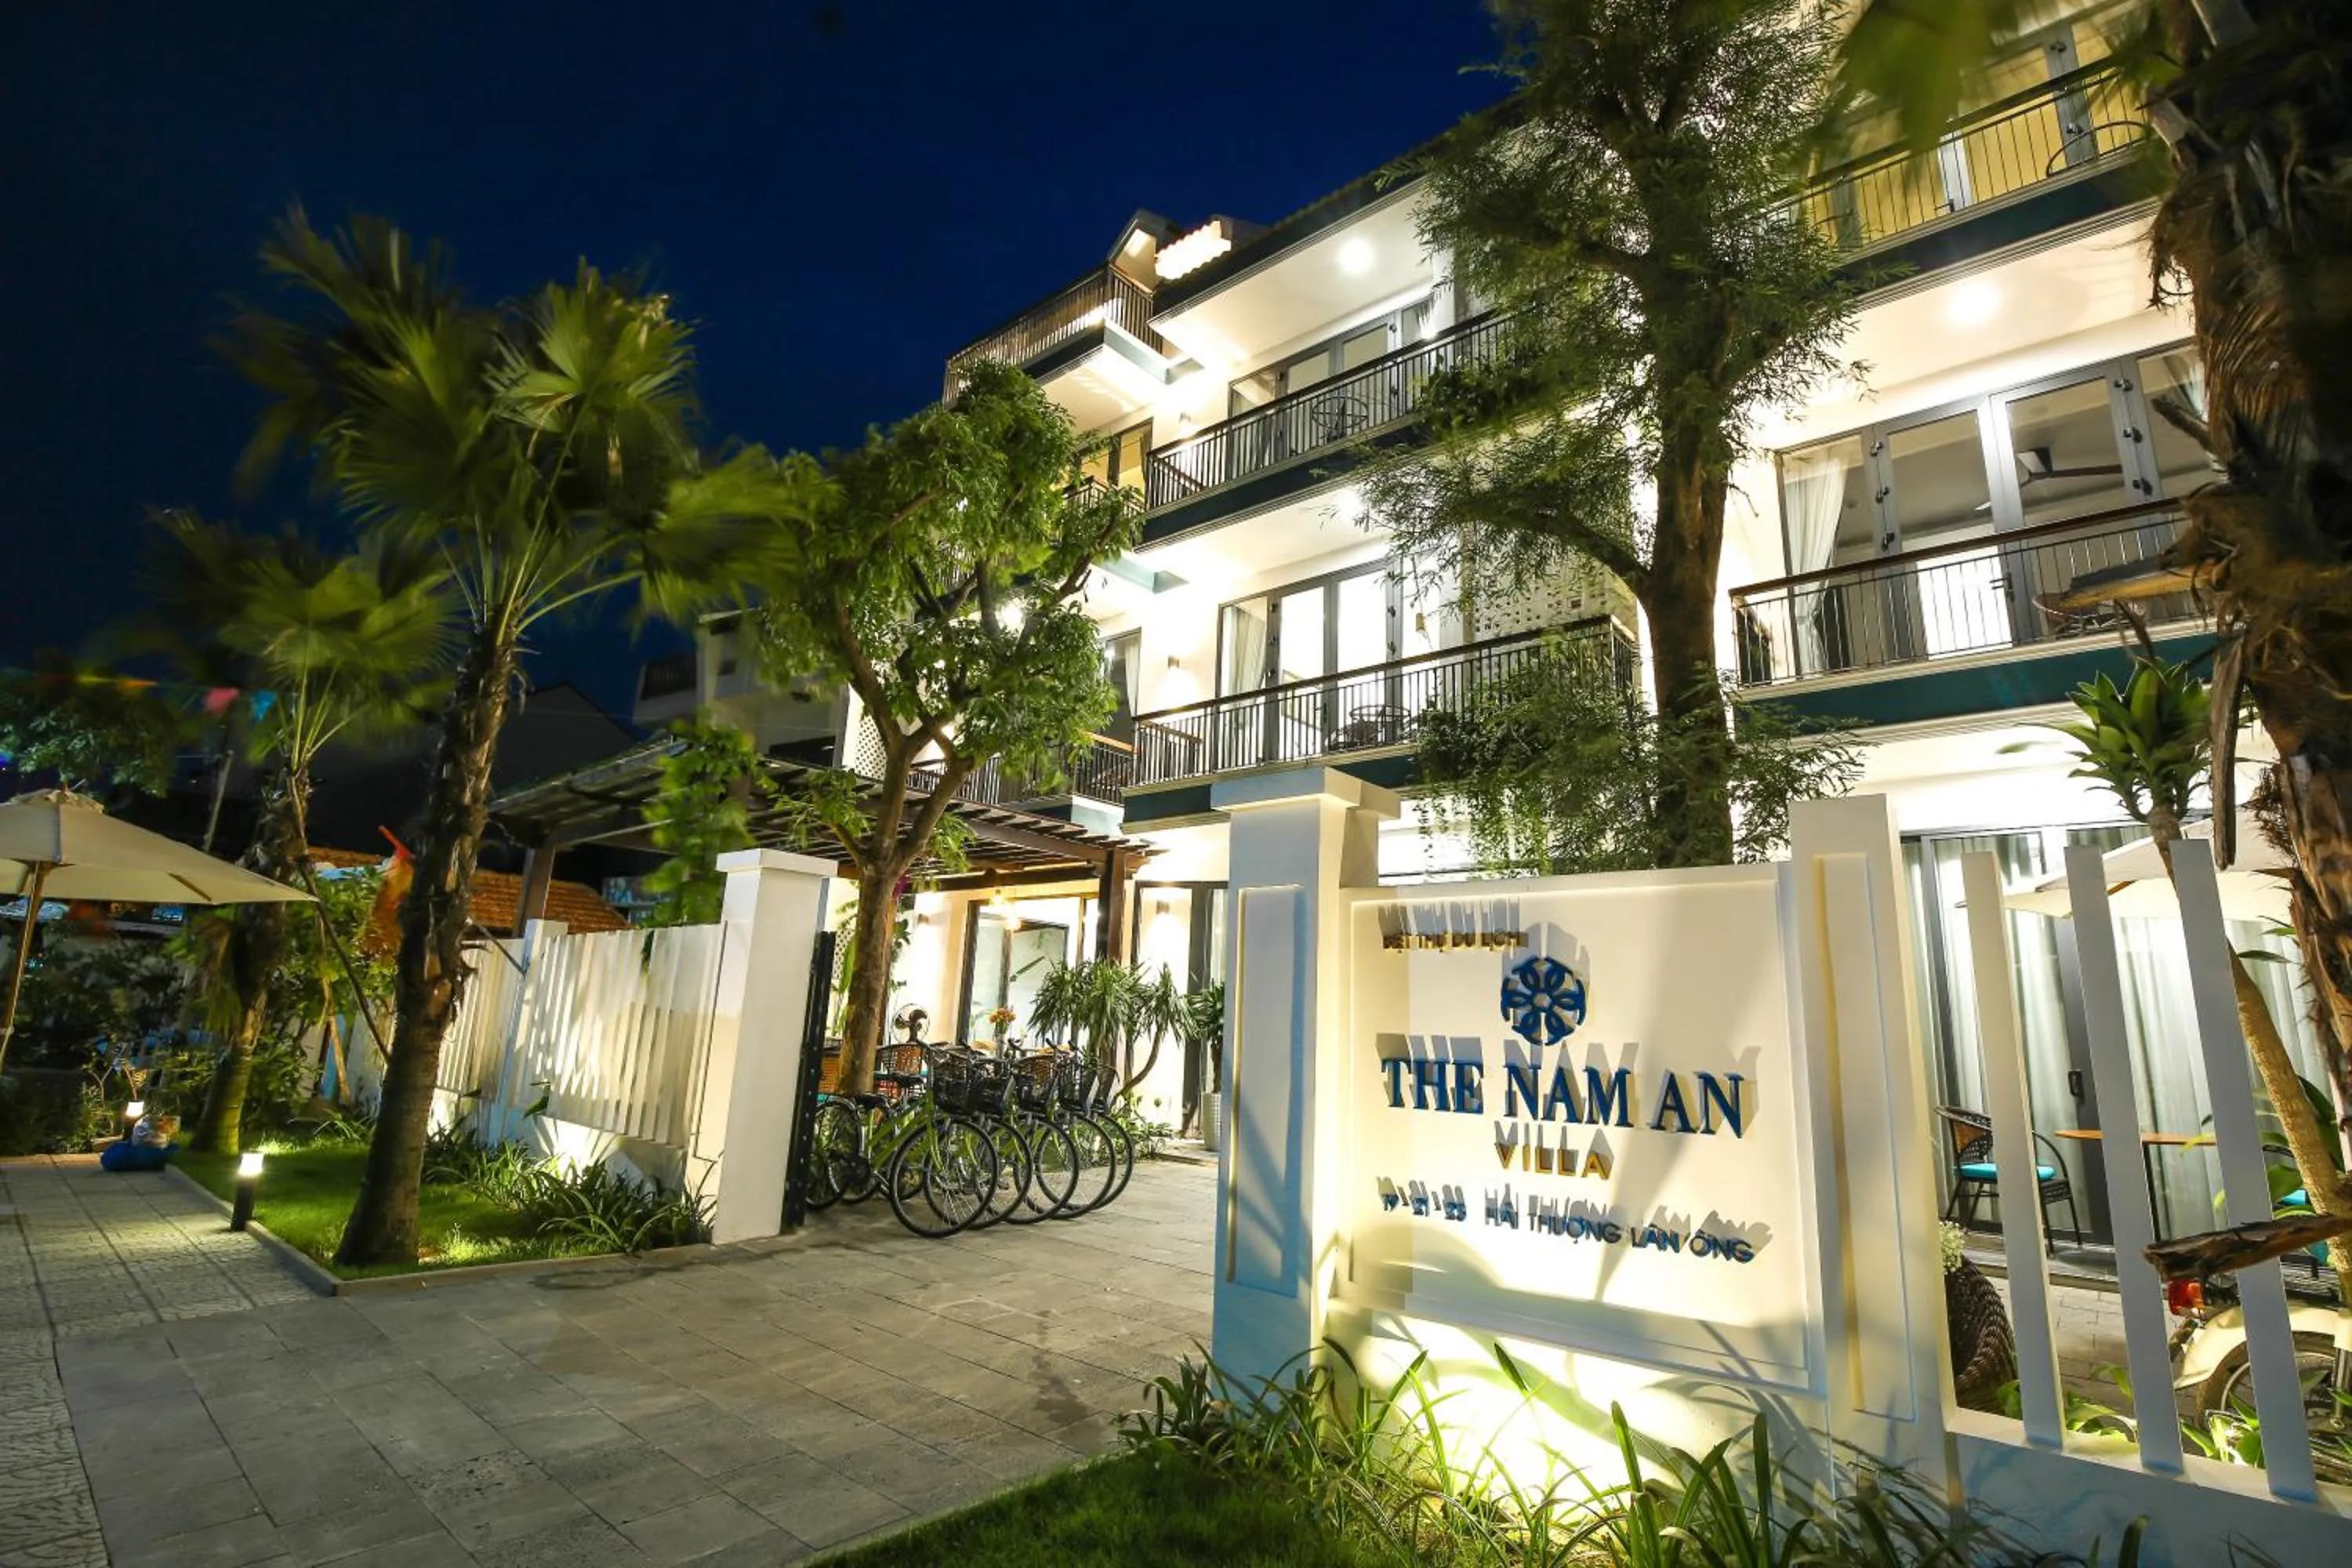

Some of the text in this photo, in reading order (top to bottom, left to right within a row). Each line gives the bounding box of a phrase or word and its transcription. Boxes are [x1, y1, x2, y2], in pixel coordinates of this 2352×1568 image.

[1381, 1057, 1744, 1139] THE NAM AN
[1494, 1142, 1610, 1180] VILLA
